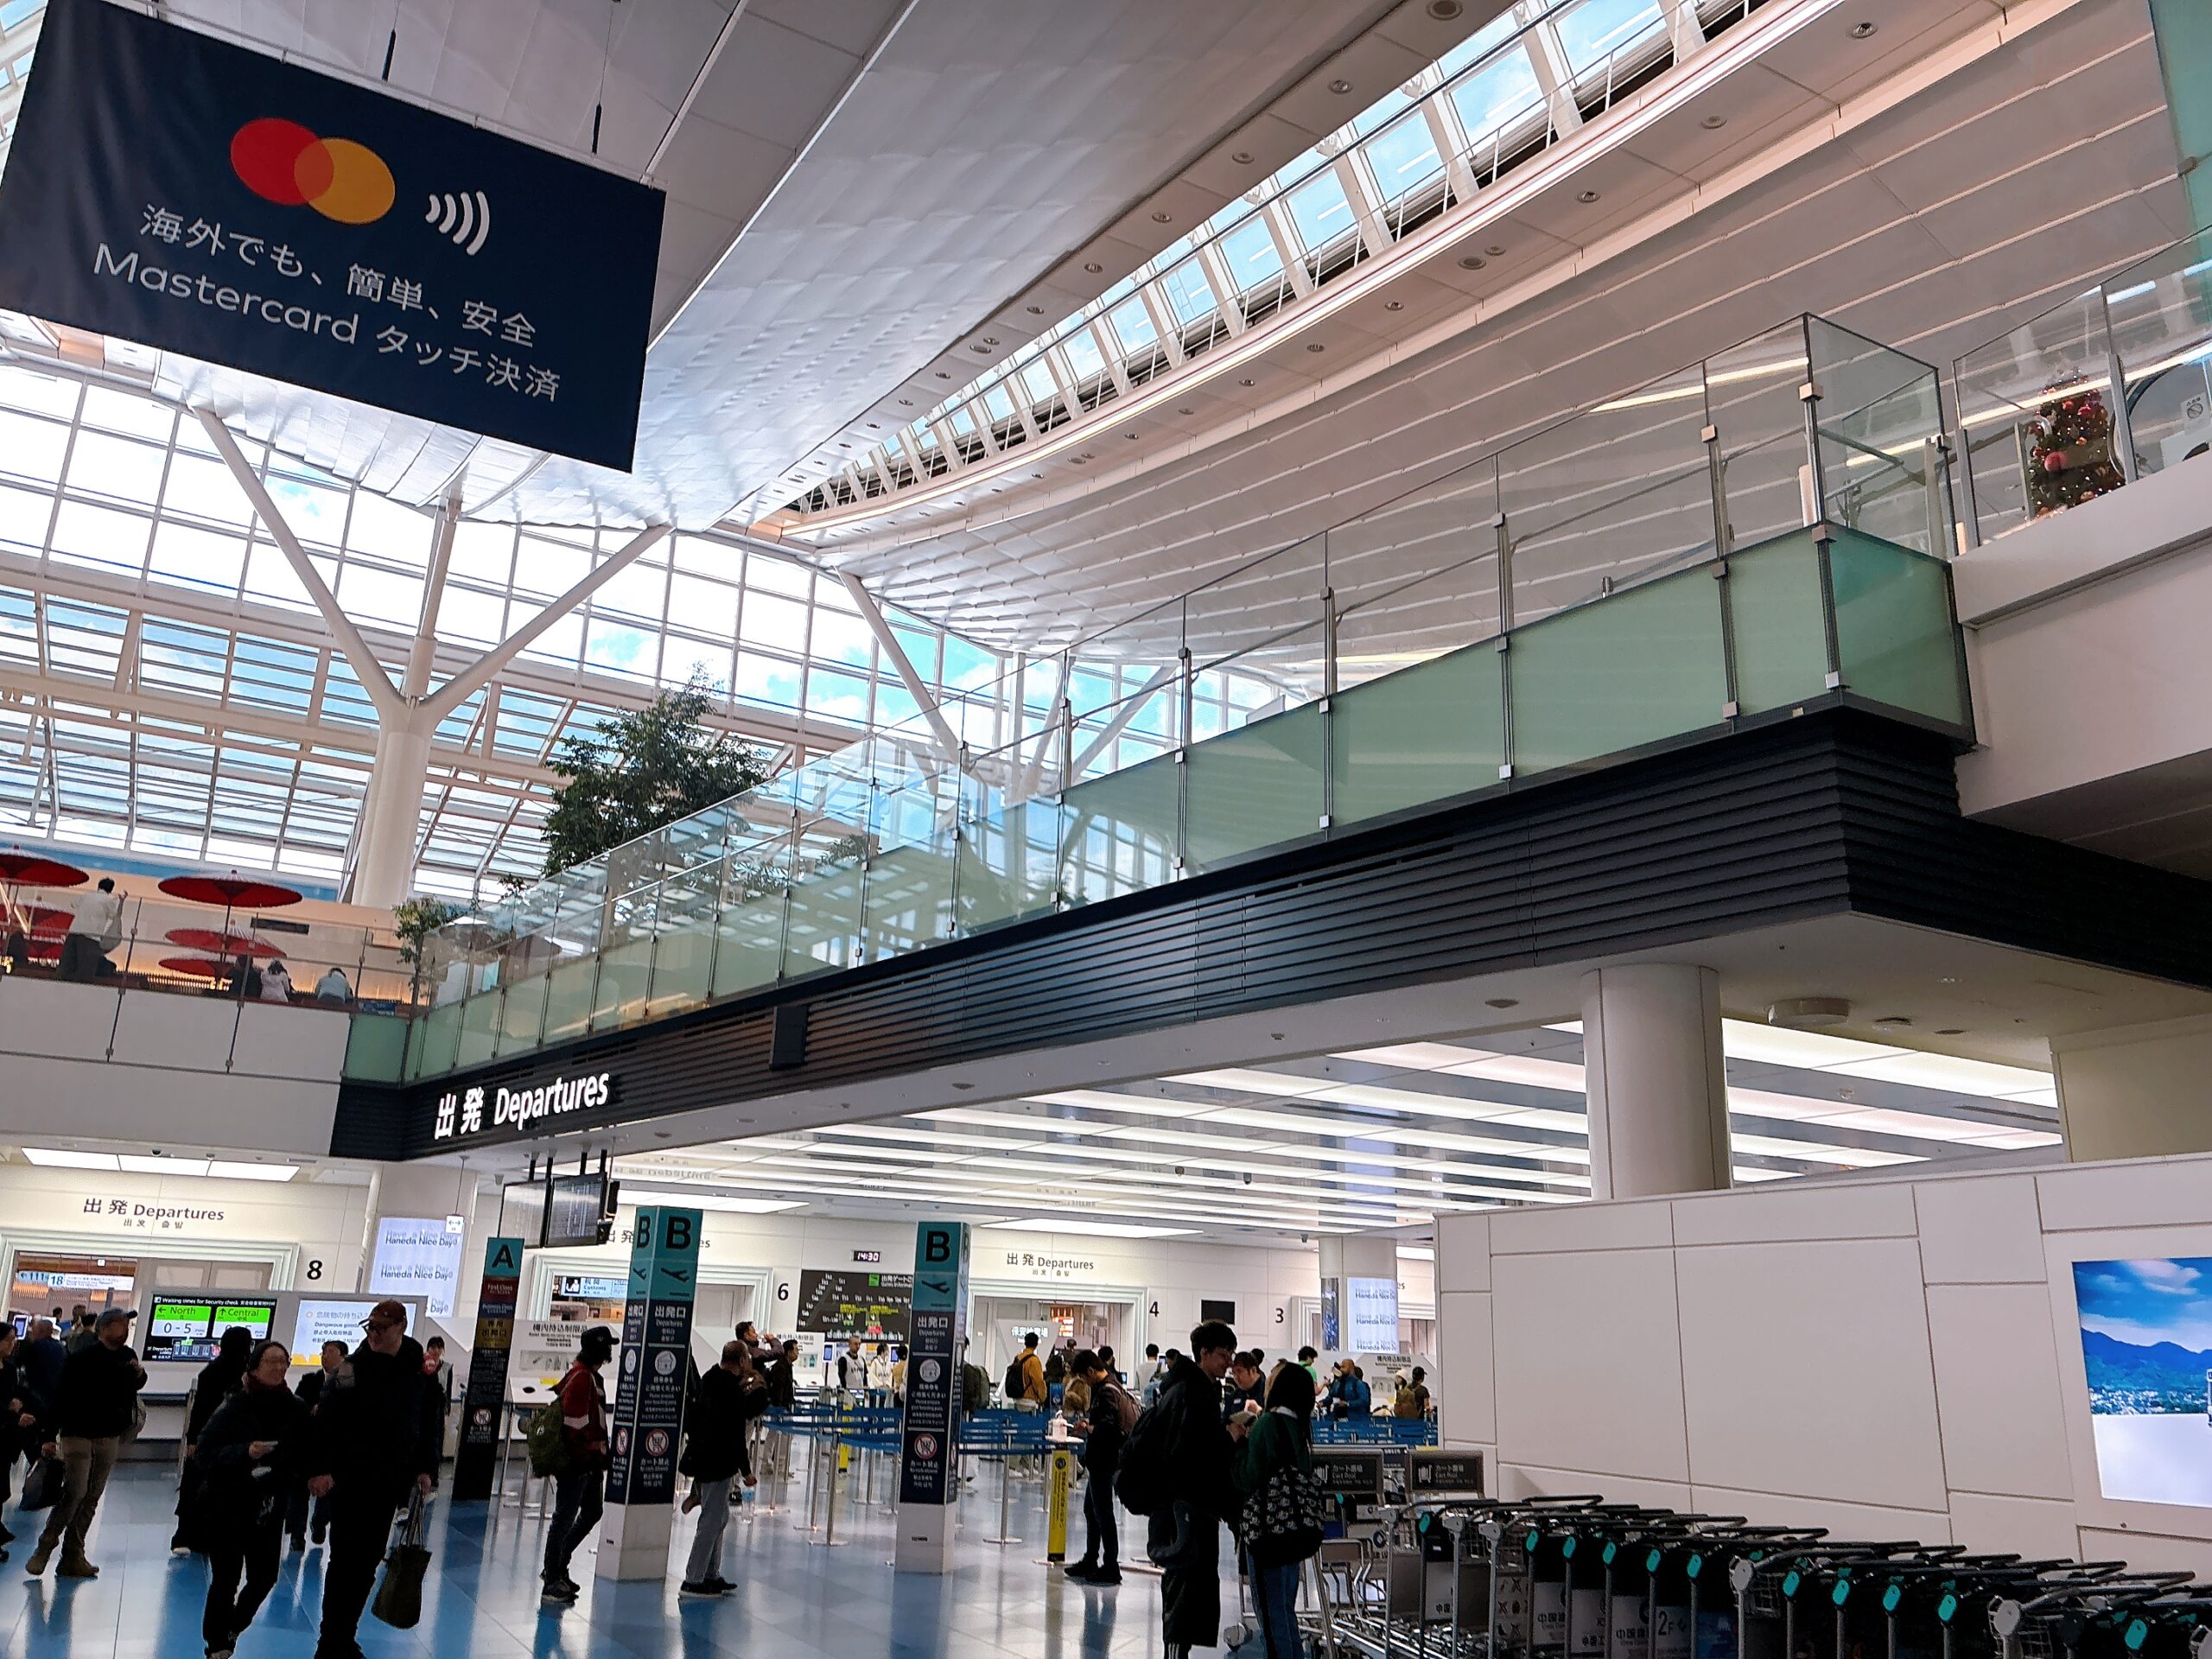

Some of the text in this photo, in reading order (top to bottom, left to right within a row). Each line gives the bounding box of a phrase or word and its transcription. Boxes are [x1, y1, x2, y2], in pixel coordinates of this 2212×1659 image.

[139, 204, 537, 347] 海外でも、簡単、安全
[94, 243, 561, 403] Mastercard タッチ決済
[493, 1072, 610, 1130] Departures
[133, 1204, 225, 1221] Departures
[637, 1215, 651, 1249] B
[665, 1216, 691, 1250] B
[925, 1230, 950, 1262] B
[492, 1244, 514, 1268] A
[857, 1252, 879, 1262] 14:30
[1038, 1257, 1094, 1269] Departures
[307, 1260, 322, 1280] 8
[50, 1275, 63, 1285] 18
[778, 1283, 789, 1300] 6
[1149, 1301, 1160, 1318] 4
[1275, 1308, 1284, 1323] 3
[164, 1323, 172, 1333] 0
[183, 1324, 192, 1333] 5
